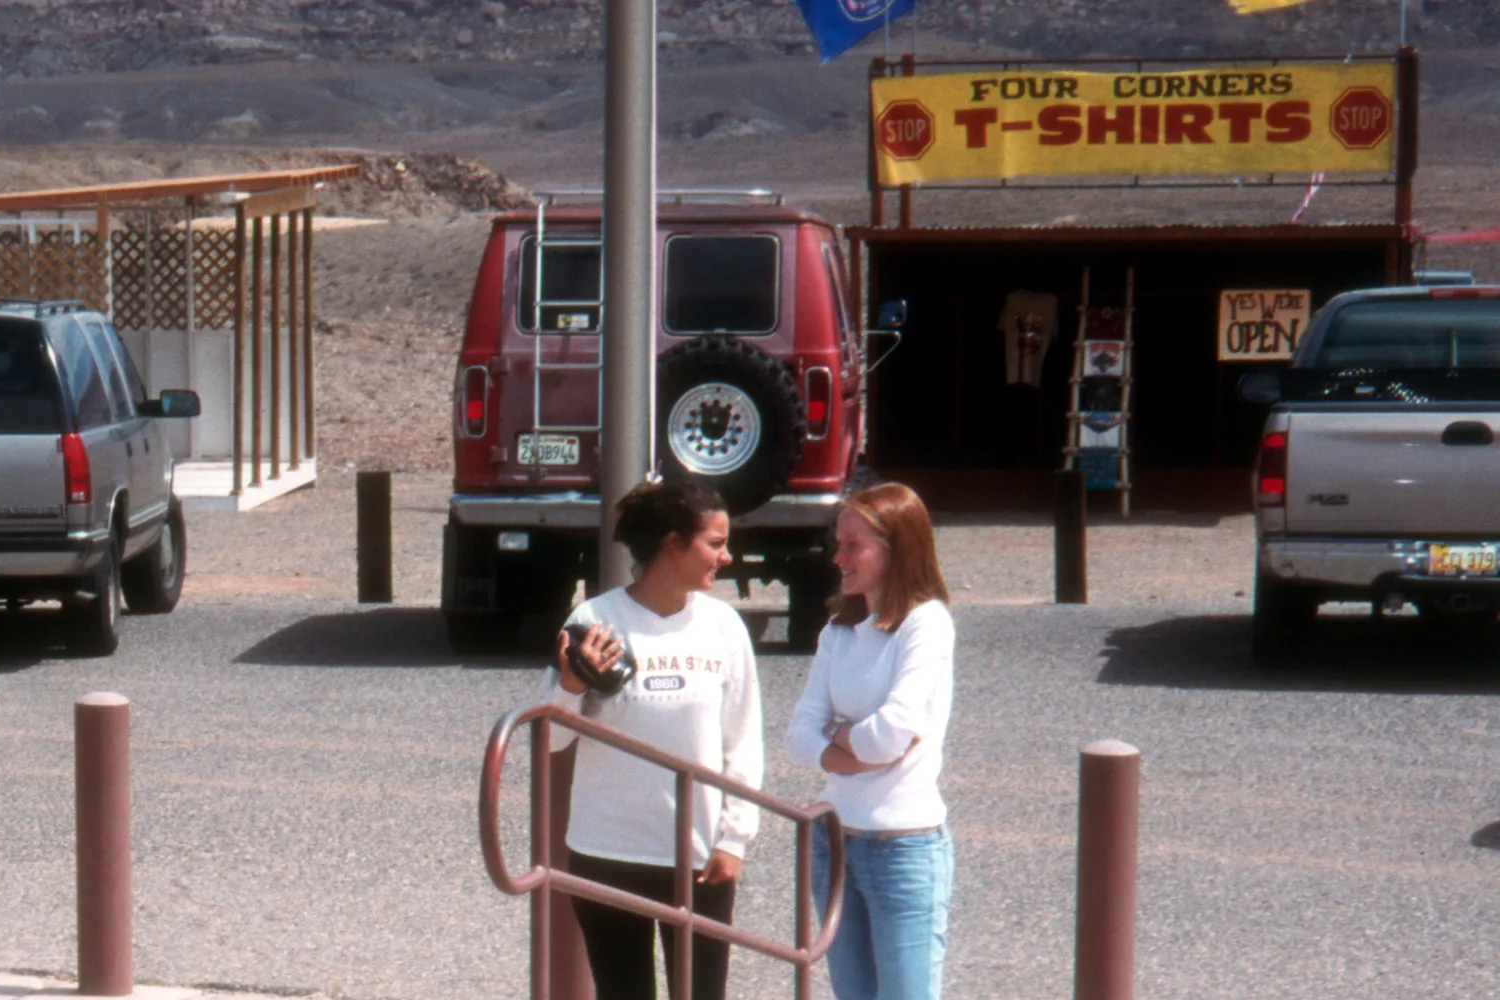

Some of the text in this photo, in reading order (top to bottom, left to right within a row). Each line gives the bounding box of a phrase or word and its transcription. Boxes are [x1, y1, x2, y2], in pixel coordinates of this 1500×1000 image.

[970, 72, 1293, 102] FOUR CORNERS
[885, 118, 926, 143] STOP
[954, 100, 1312, 149] T-SHIRTS
[1339, 106, 1382, 131] STOP
[1224, 292, 1258, 321] YES
[1226, 318, 1301, 354] OPEN
